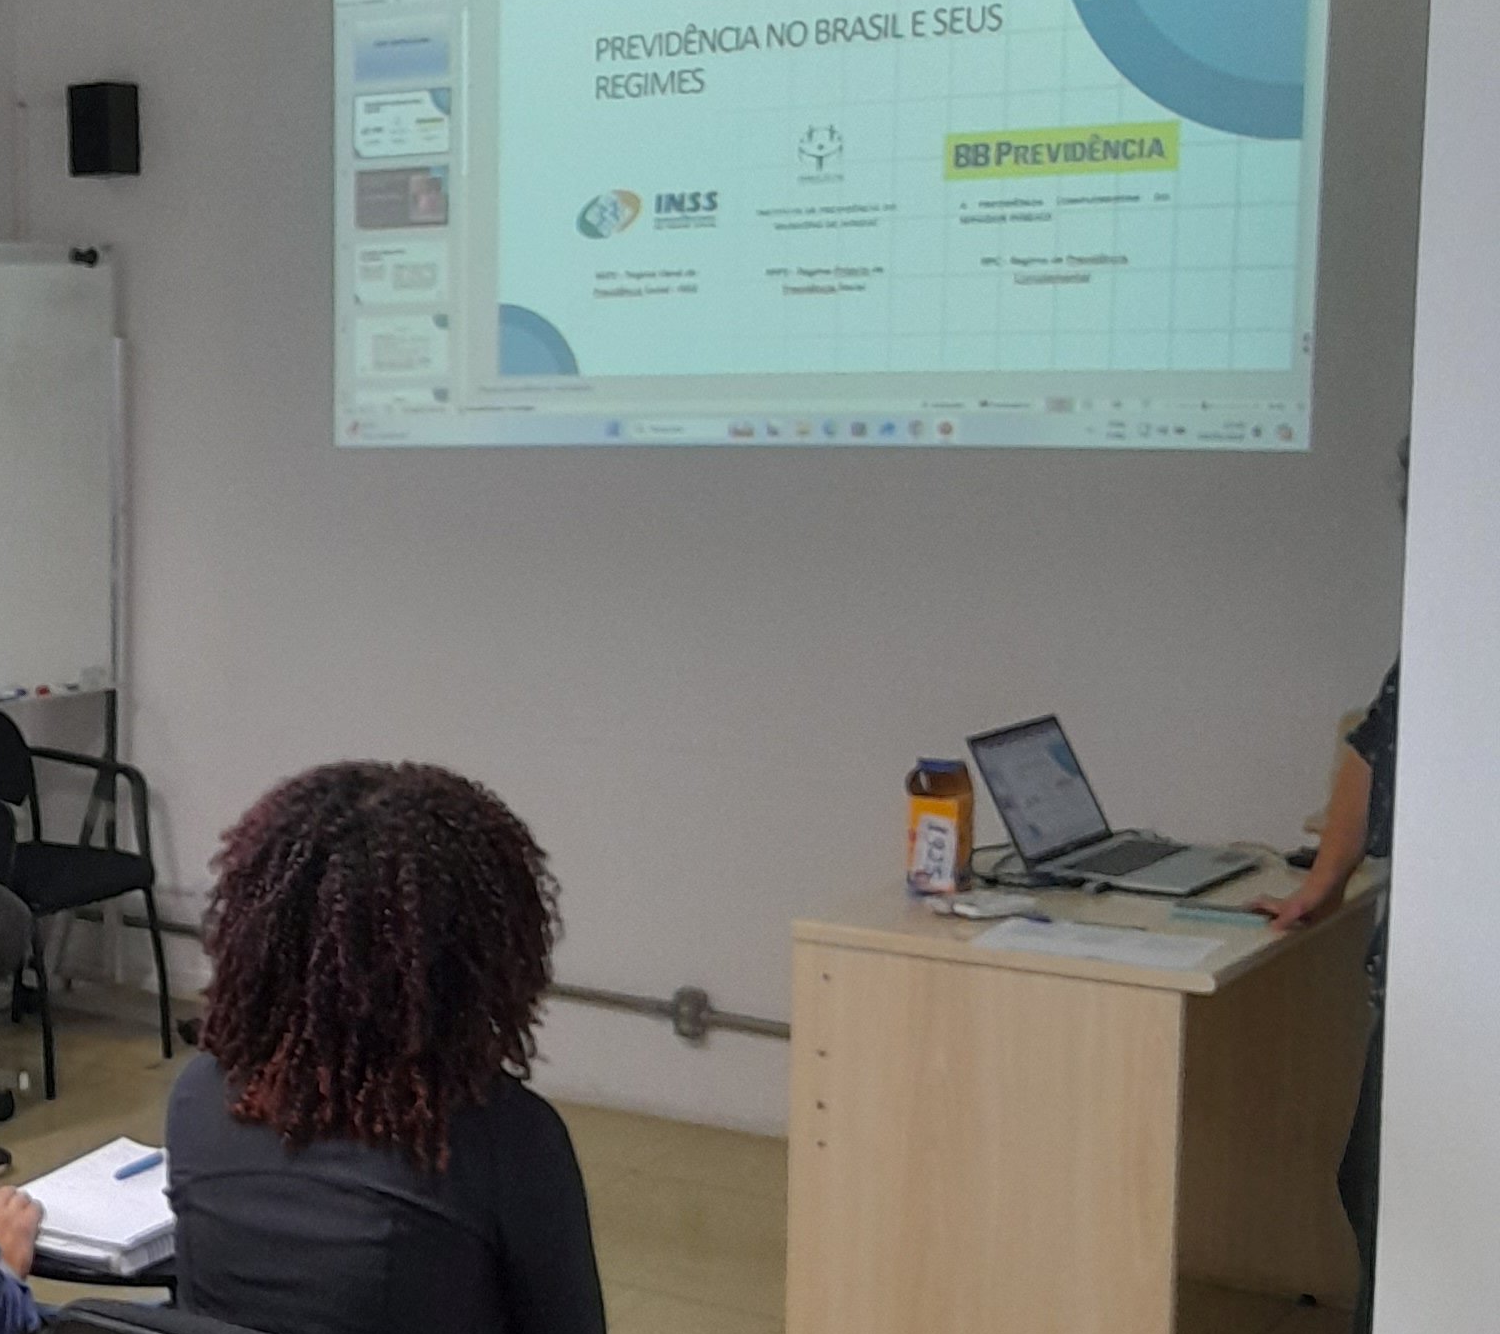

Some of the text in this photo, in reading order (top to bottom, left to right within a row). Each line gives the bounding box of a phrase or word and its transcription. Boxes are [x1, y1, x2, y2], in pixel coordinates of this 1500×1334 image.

[595, 3, 1004, 62] PREVIDÊNCIA NO BRASIL E SEUS
[595, 68, 706, 100] REGIMES
[953, 133, 1167, 168] BB PREVIDÊNCIA
[653, 191, 718, 215] INSS
